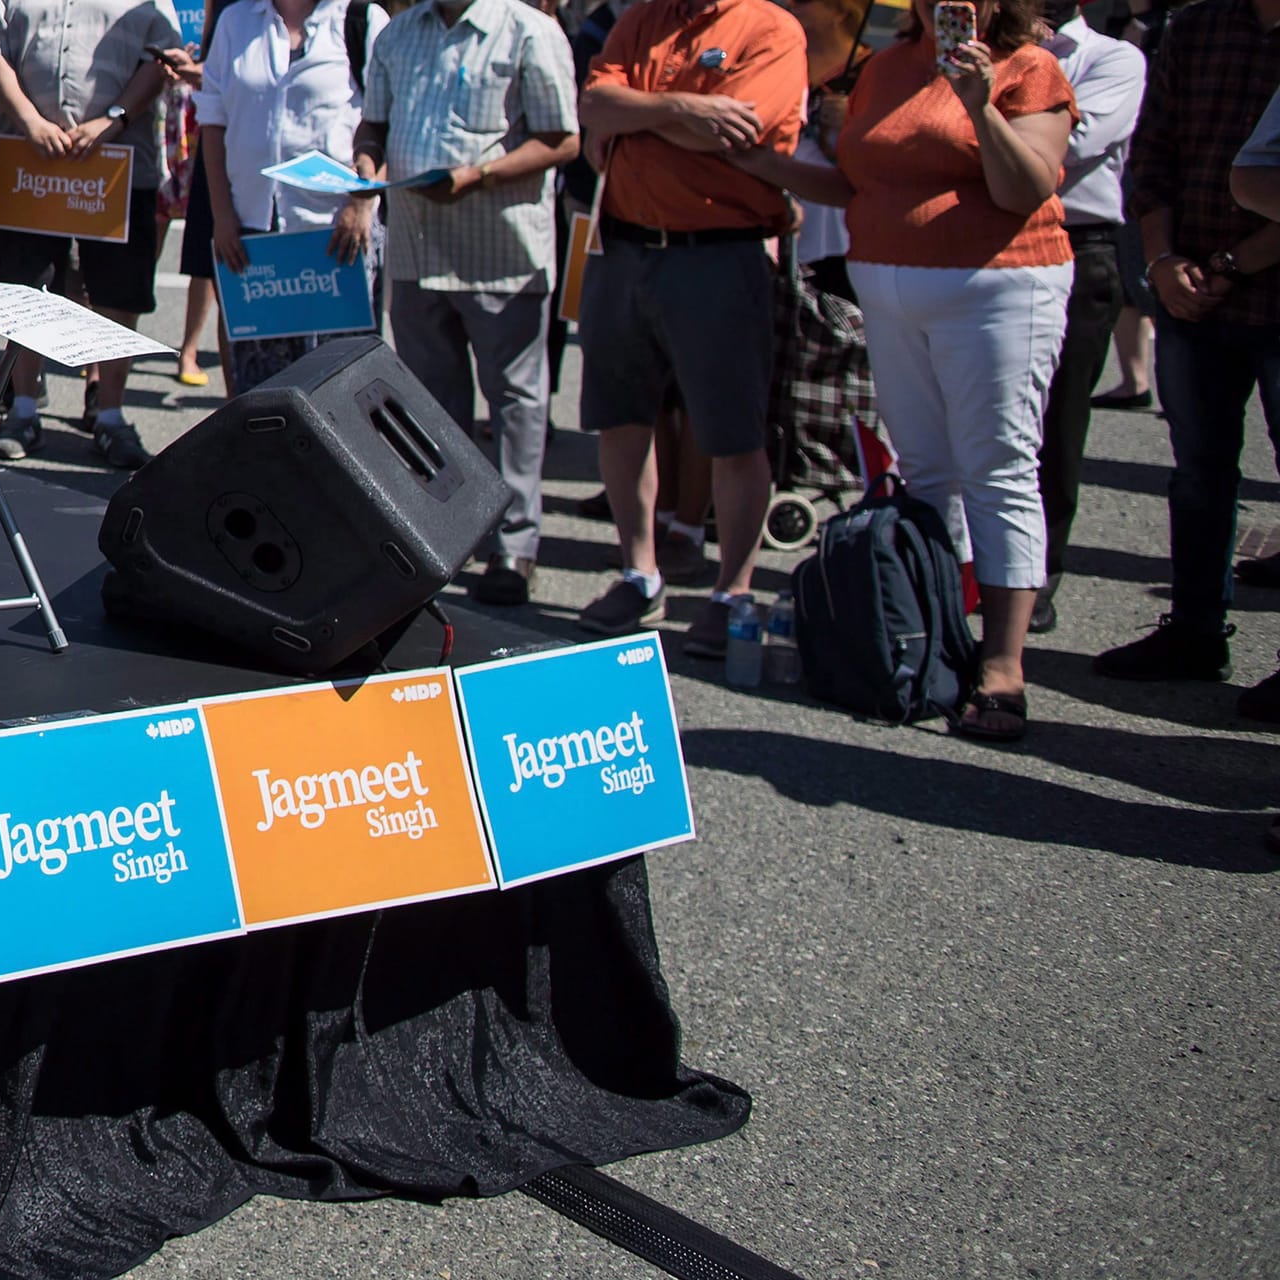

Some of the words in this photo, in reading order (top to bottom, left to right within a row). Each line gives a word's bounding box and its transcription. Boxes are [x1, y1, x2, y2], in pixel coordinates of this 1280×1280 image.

[12, 167, 108, 198] Jagmeet
[66, 196, 106, 214] Singh
[241, 267, 341, 303] Jagmeet
[628, 646, 655, 665] NDP
[404, 682, 442, 701] NDP
[157, 718, 195, 738] NDP
[502, 711, 649, 793] Jagmeet
[251, 751, 429, 832] Jagmeet
[600, 758, 655, 795] Singh
[366, 800, 439, 839] Singh
[112, 841, 188, 884] Singh
